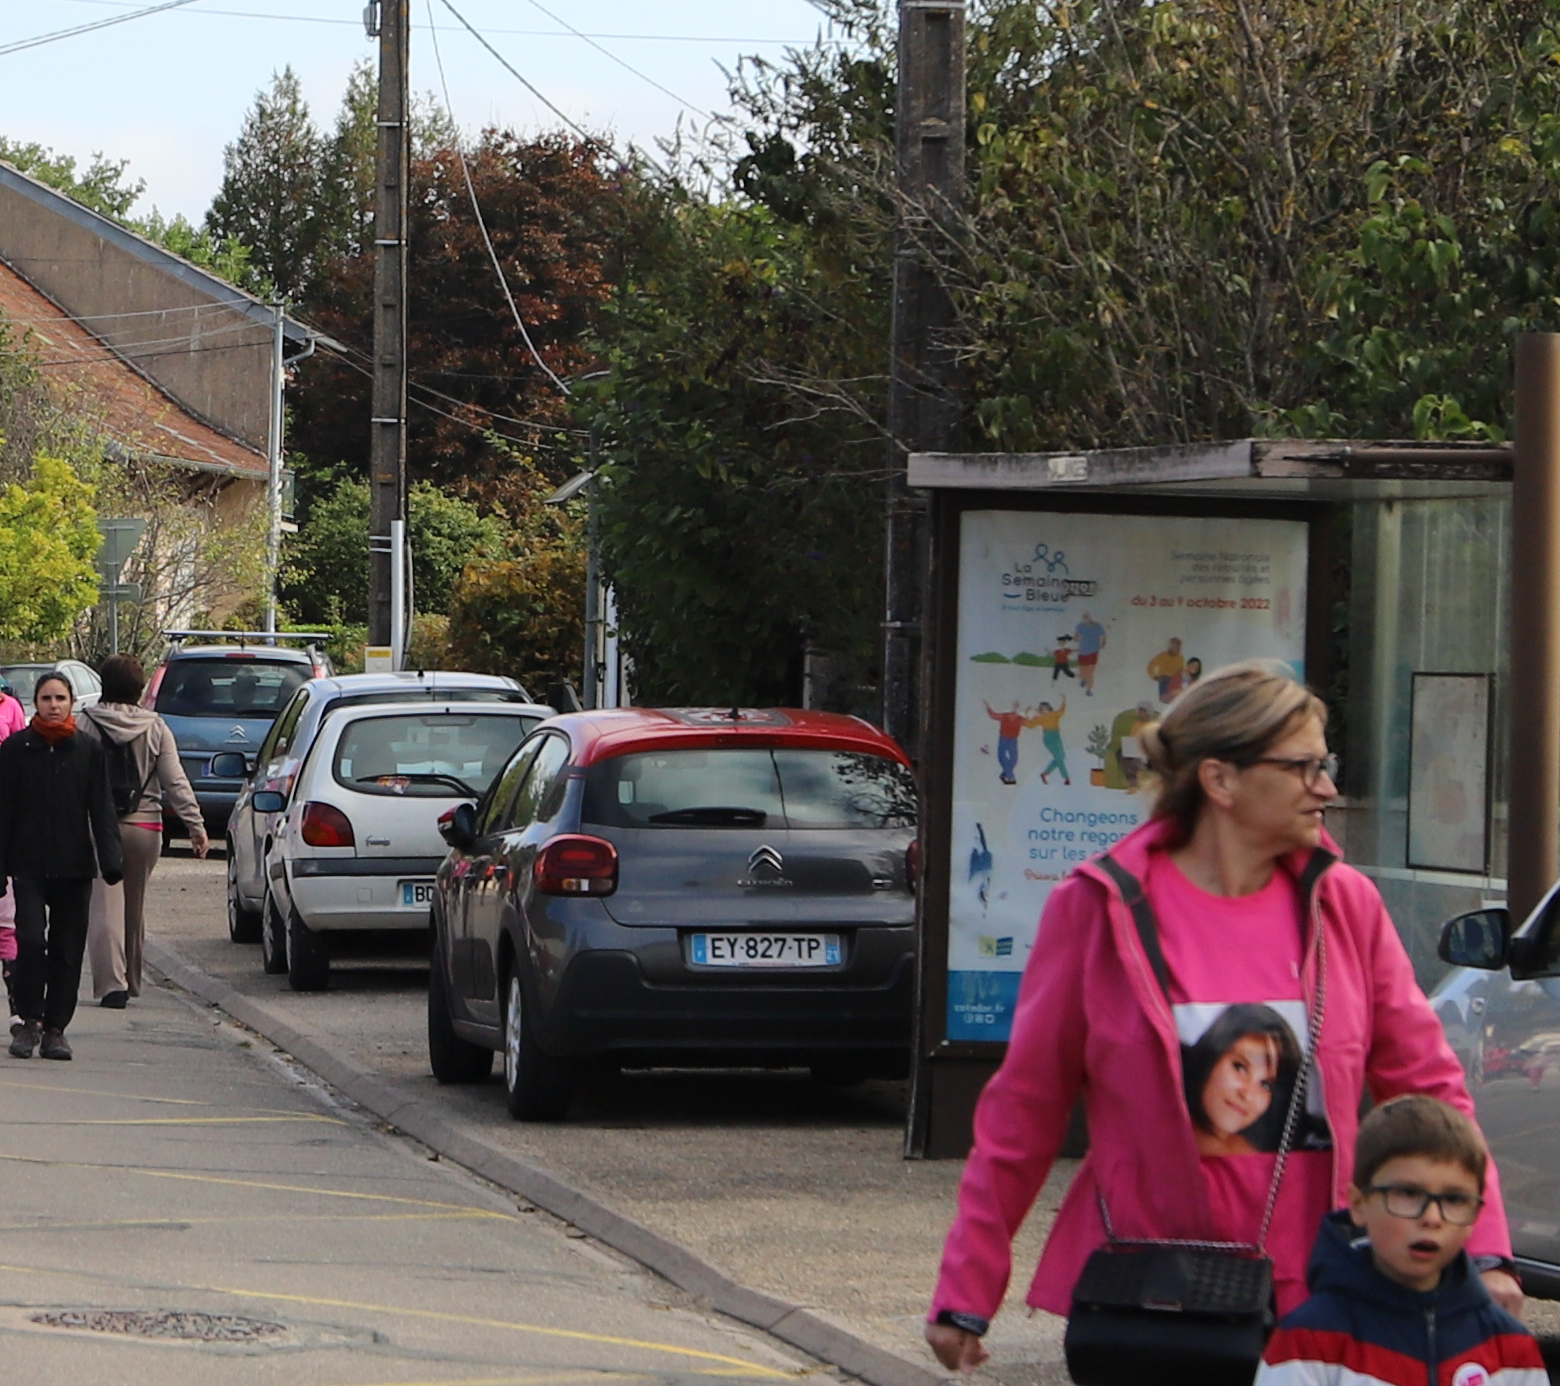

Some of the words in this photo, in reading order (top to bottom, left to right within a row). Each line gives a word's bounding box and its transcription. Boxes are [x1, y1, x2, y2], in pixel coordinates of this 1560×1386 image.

[1014, 563, 1032, 573] La
[1026, 589, 1069, 602] Bleue
[1131, 595, 1146, 606] du
[1149, 596, 1157, 606] 3
[1186, 597, 1236, 609] octobre
[1240, 599, 1270, 610] 2022
[1040, 807, 1138, 827] Changeons
[1028, 829, 1074, 842] notre
[1029, 848, 1058, 860] sur
[1063, 846, 1087, 861] les
[711, 936, 821, 959] EY-827-TP
